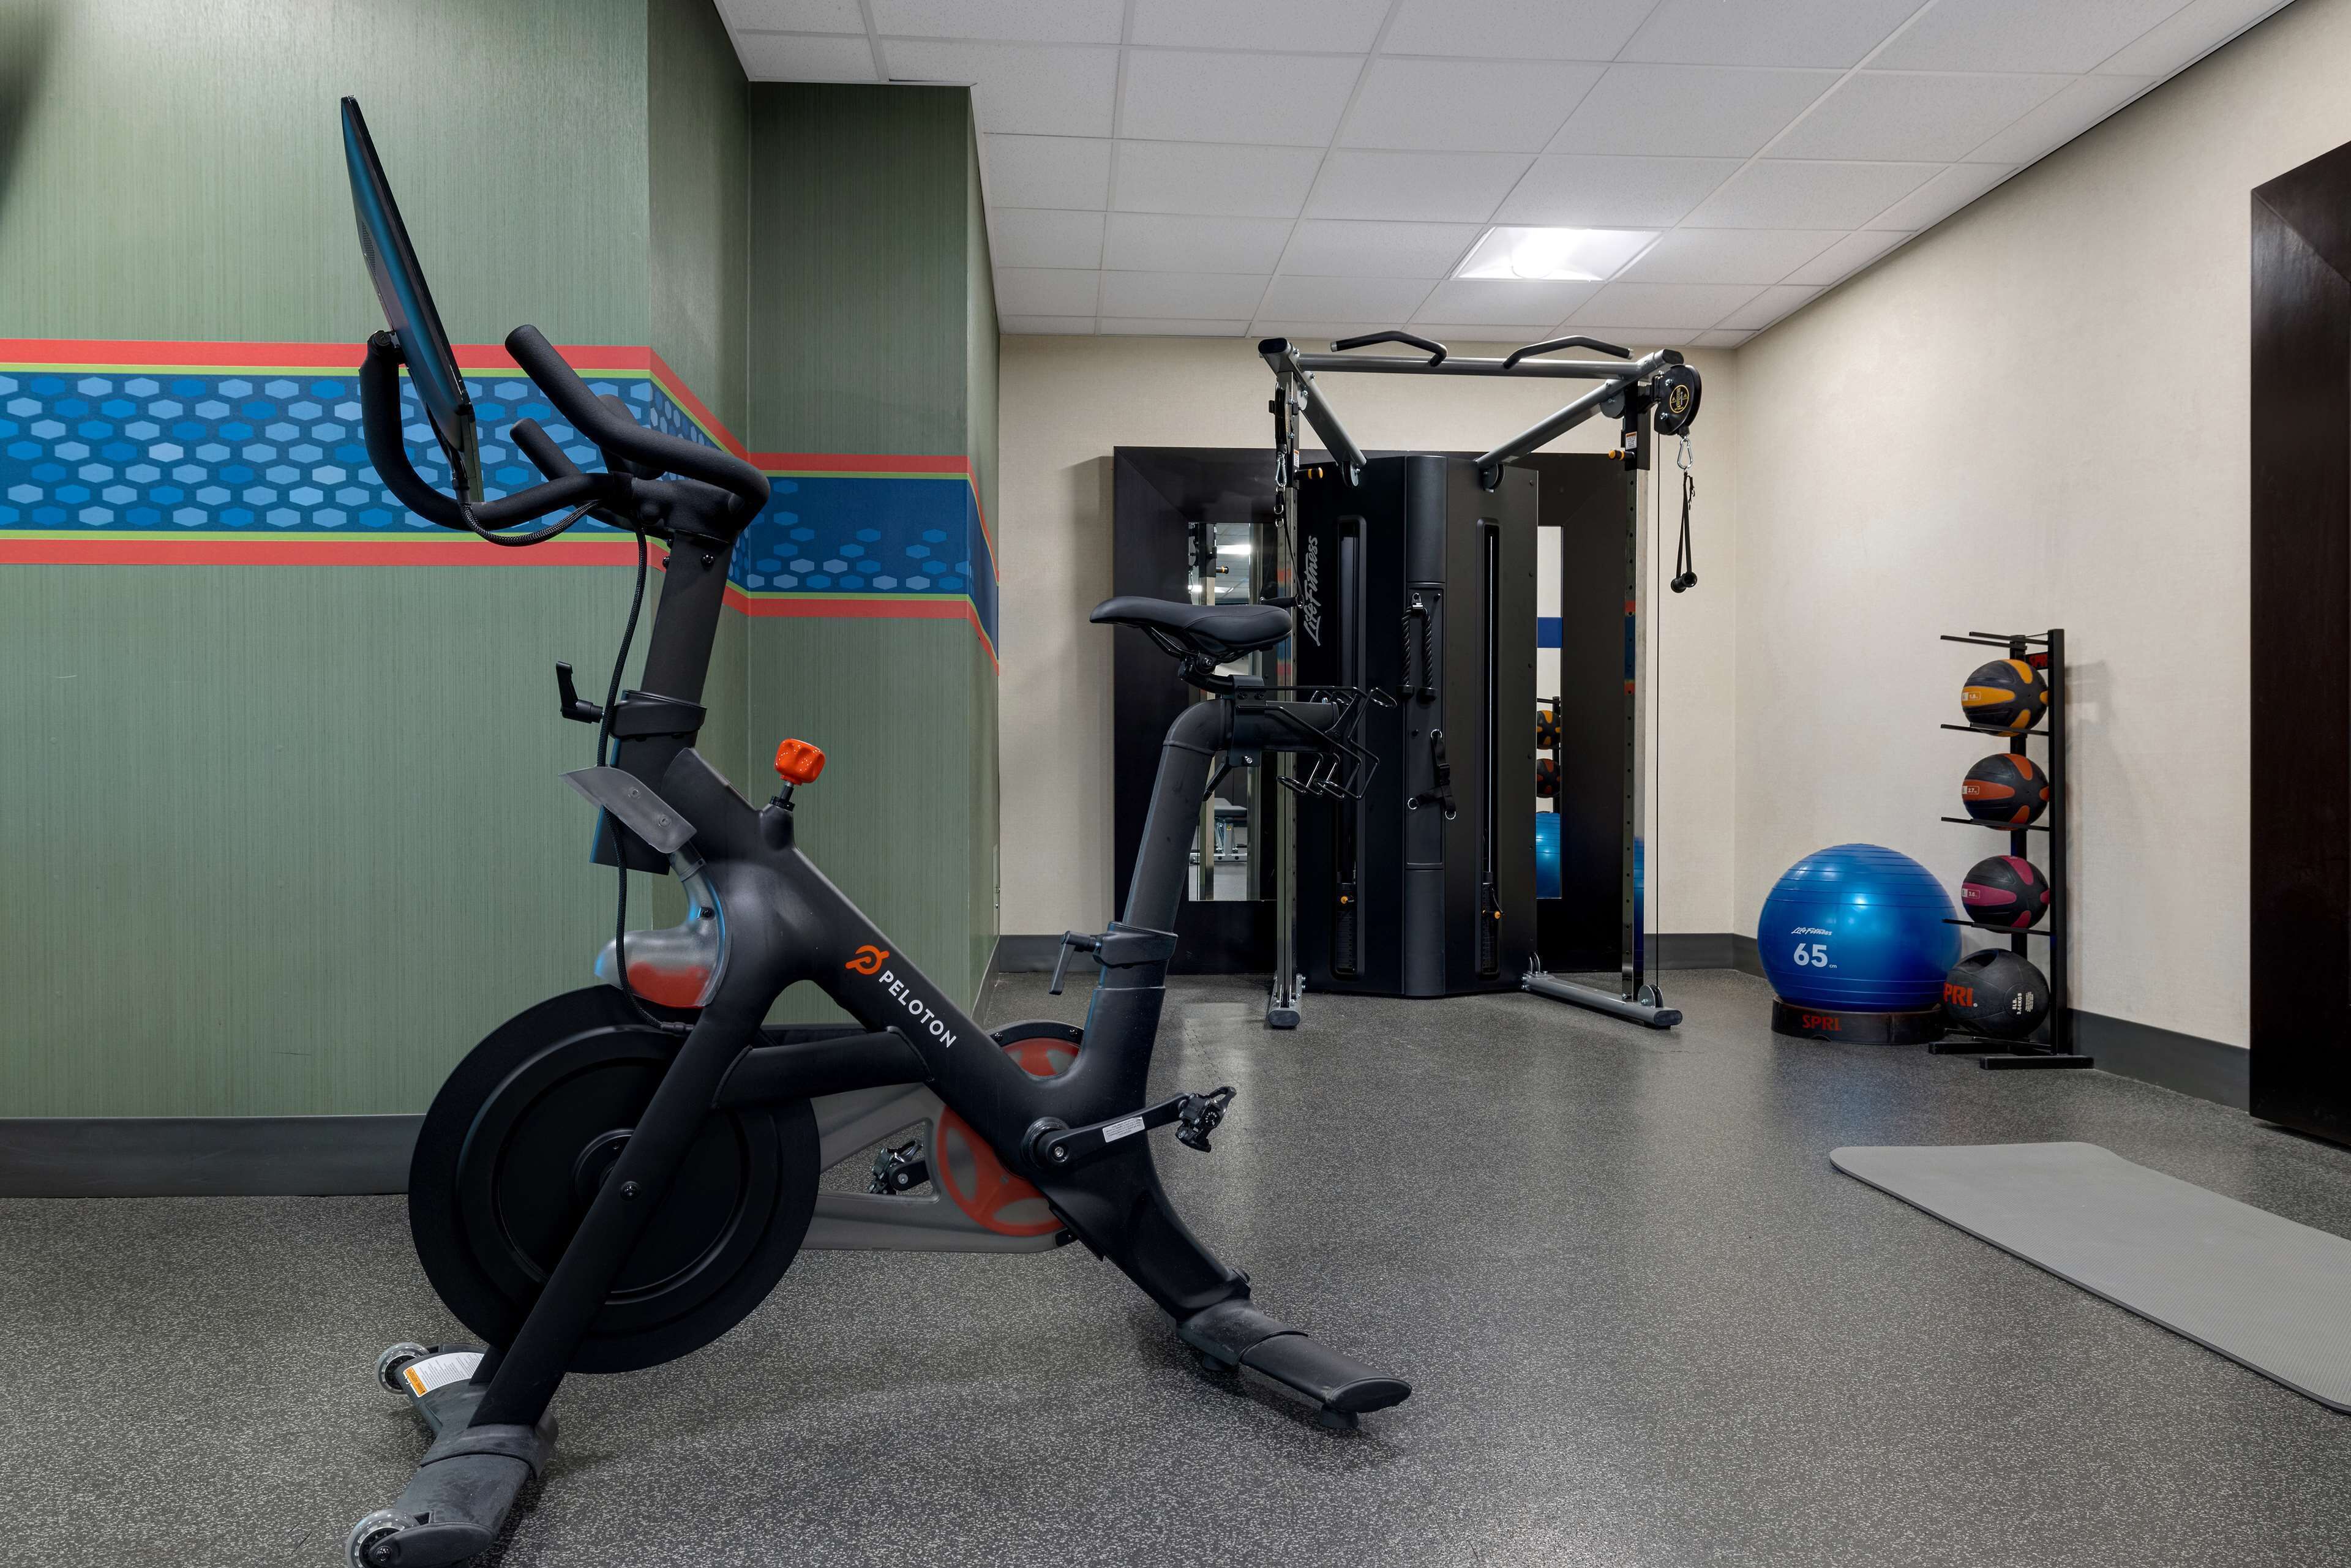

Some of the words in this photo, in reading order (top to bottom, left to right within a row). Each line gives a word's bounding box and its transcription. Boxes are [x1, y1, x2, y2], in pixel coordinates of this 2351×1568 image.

[2029, 654, 2048, 667] SPR
[1794, 943, 1828, 967] 65
[1943, 982, 1973, 1007] PRI
[878, 970, 956, 1048] PELOTON
[1802, 1015, 1842, 1031] SPRI
